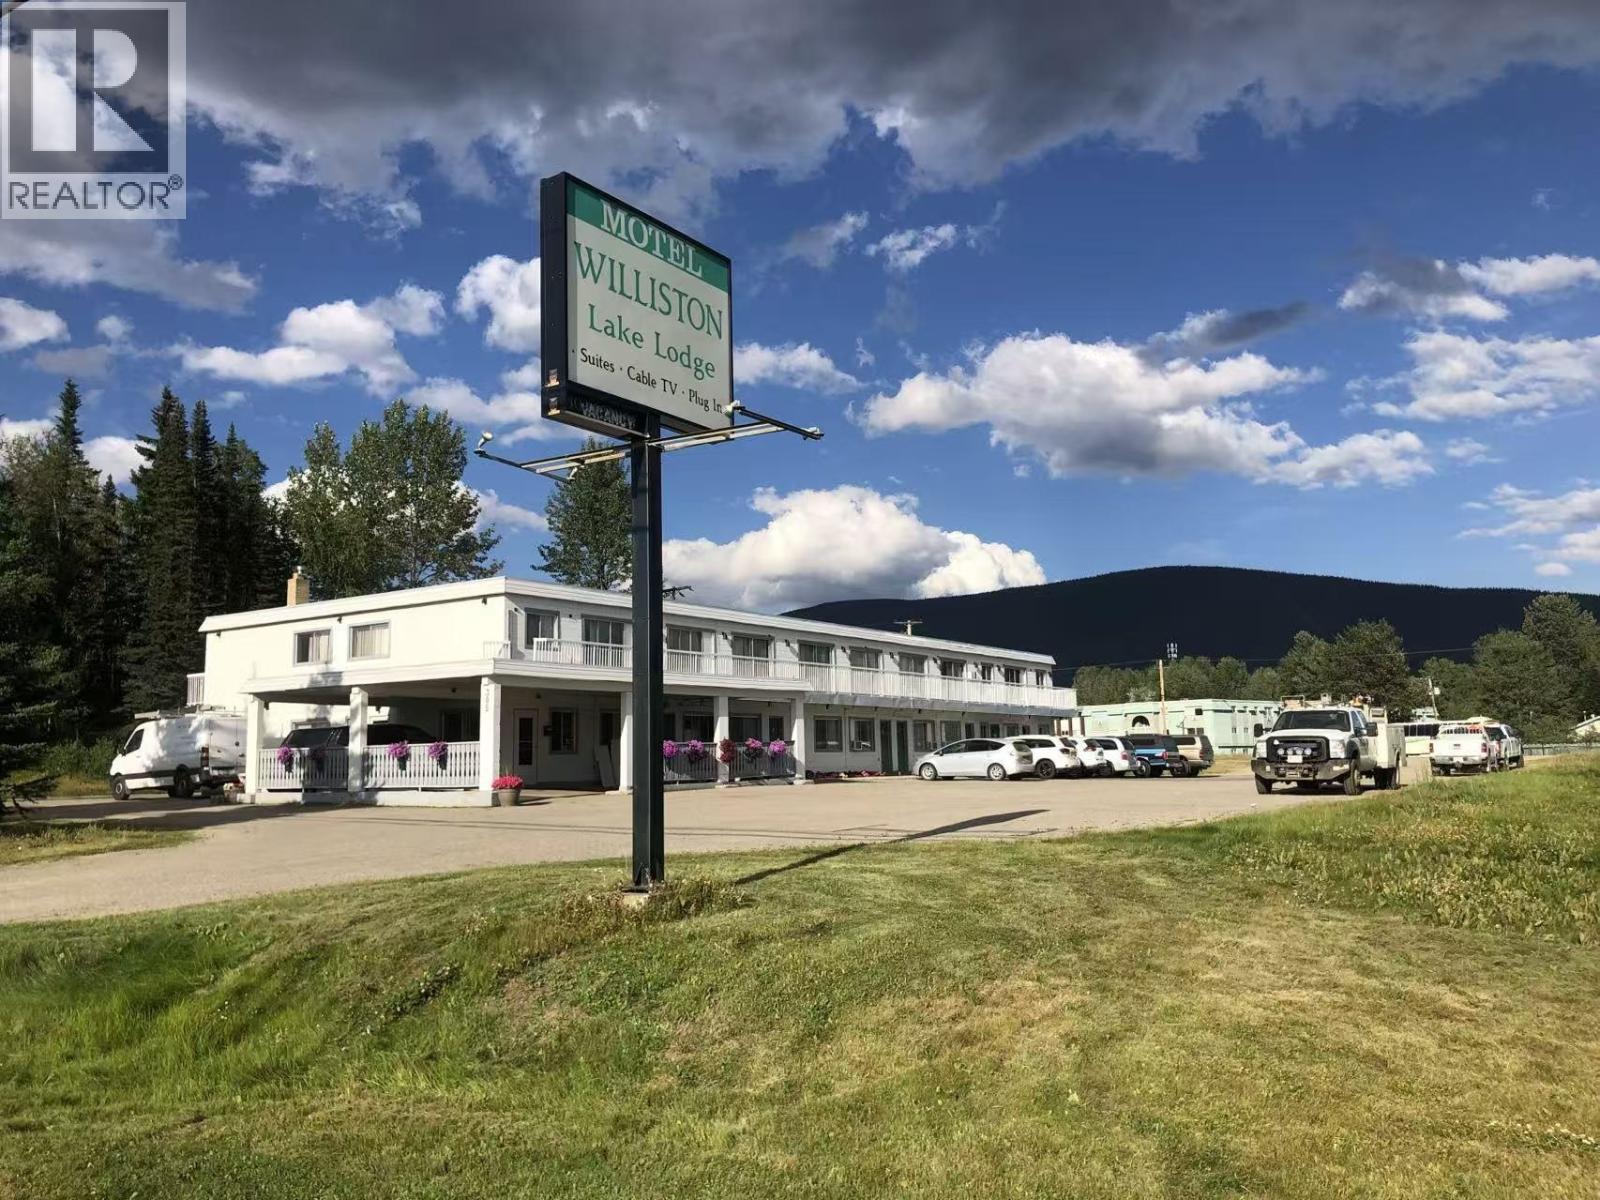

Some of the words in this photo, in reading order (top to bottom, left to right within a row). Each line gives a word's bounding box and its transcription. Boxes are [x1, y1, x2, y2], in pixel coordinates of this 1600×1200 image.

[600, 198, 702, 279] MOTEL
[574, 241, 722, 340] WILLISTON
[580, 348, 615, 373] Suites
[627, 365, 657, 389] Cable
[661, 378, 678, 395] TV
[688, 388, 709, 412] Plug
[713, 398, 723, 414] In
[588, 303, 644, 349] Lake
[654, 331, 715, 381] Lodge
